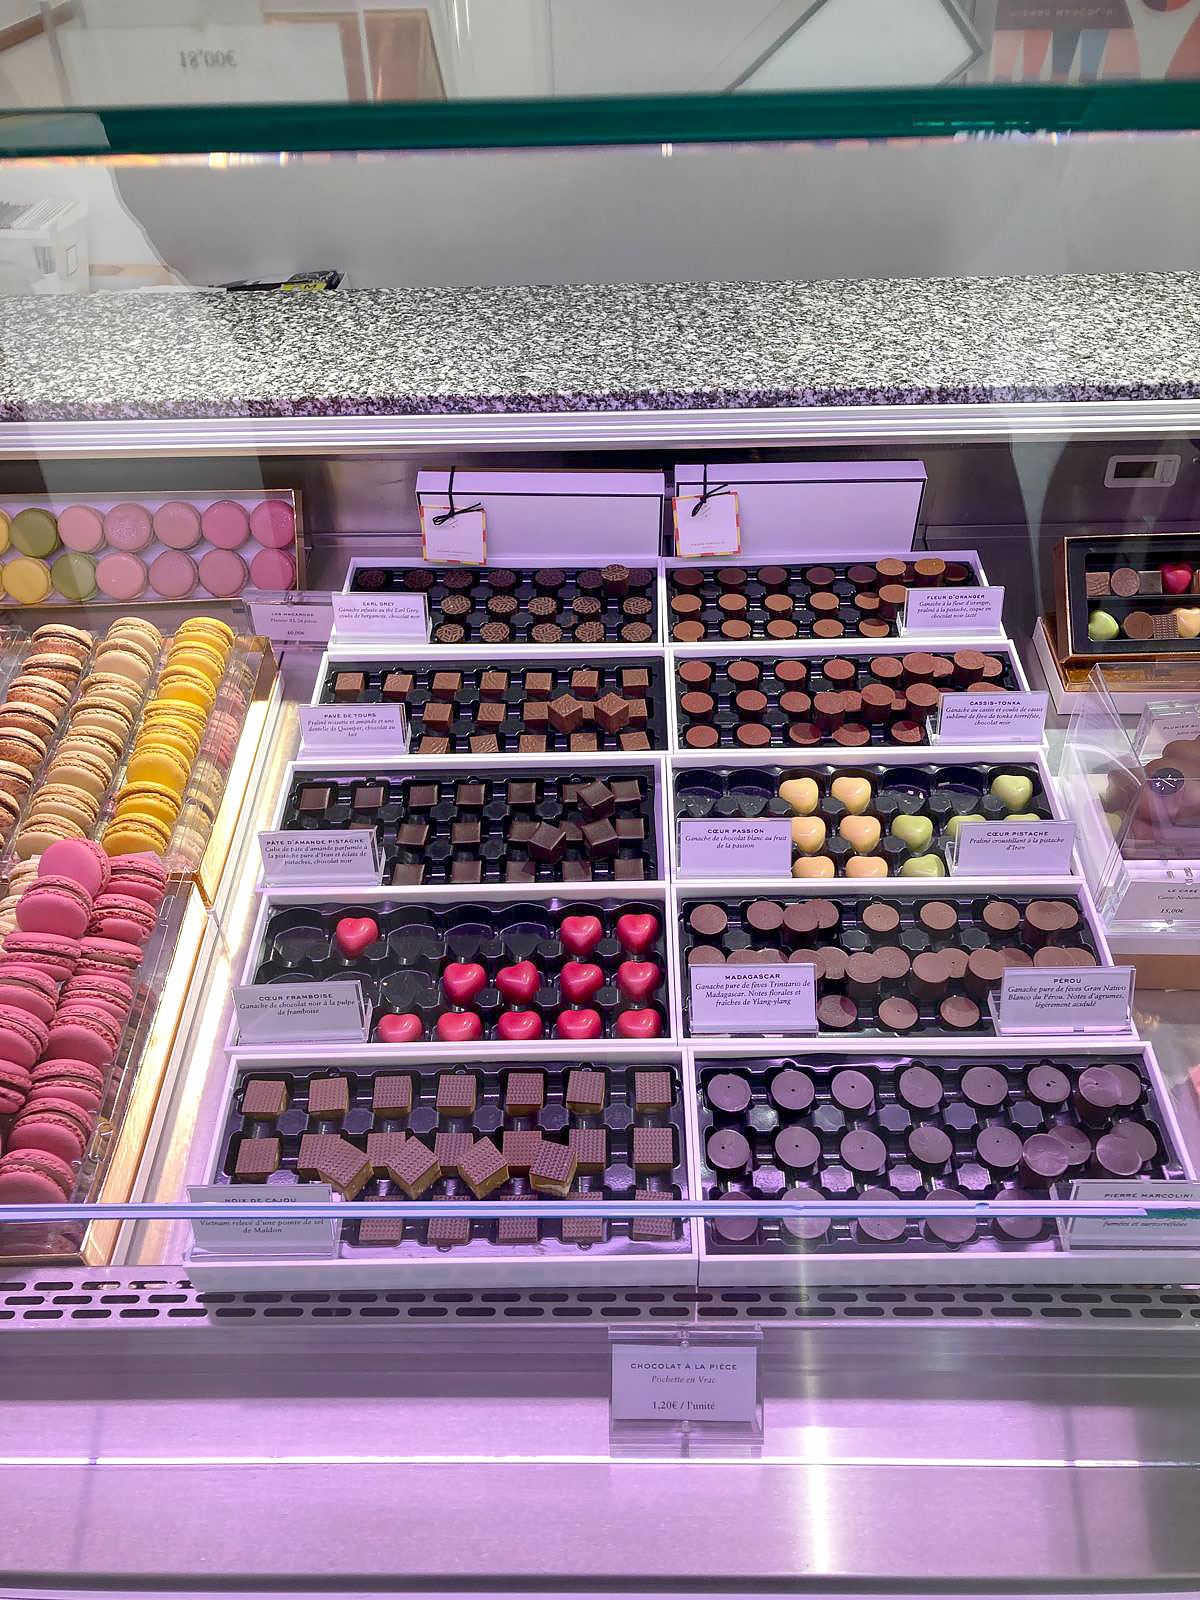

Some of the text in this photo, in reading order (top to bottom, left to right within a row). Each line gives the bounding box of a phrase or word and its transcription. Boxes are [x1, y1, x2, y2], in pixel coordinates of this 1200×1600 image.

[724, 973, 781, 981] MADAGASCAR
[724, 982, 741, 991] pure
[705, 990, 746, 999] Madagascar.
[768, 989, 794, 997] florales
[239, 1002, 268, 1010] Ganache
[752, 998, 792, 1006] Ylang-ylang
[684, 1361, 692, 1370] À
[709, 1362, 738, 1371] PIÈCE
[651, 1375, 685, 1384] Pochette
[698, 1375, 717, 1384] Vrac
[652, 1400, 716, 1411] 1,20€ / l'unité
